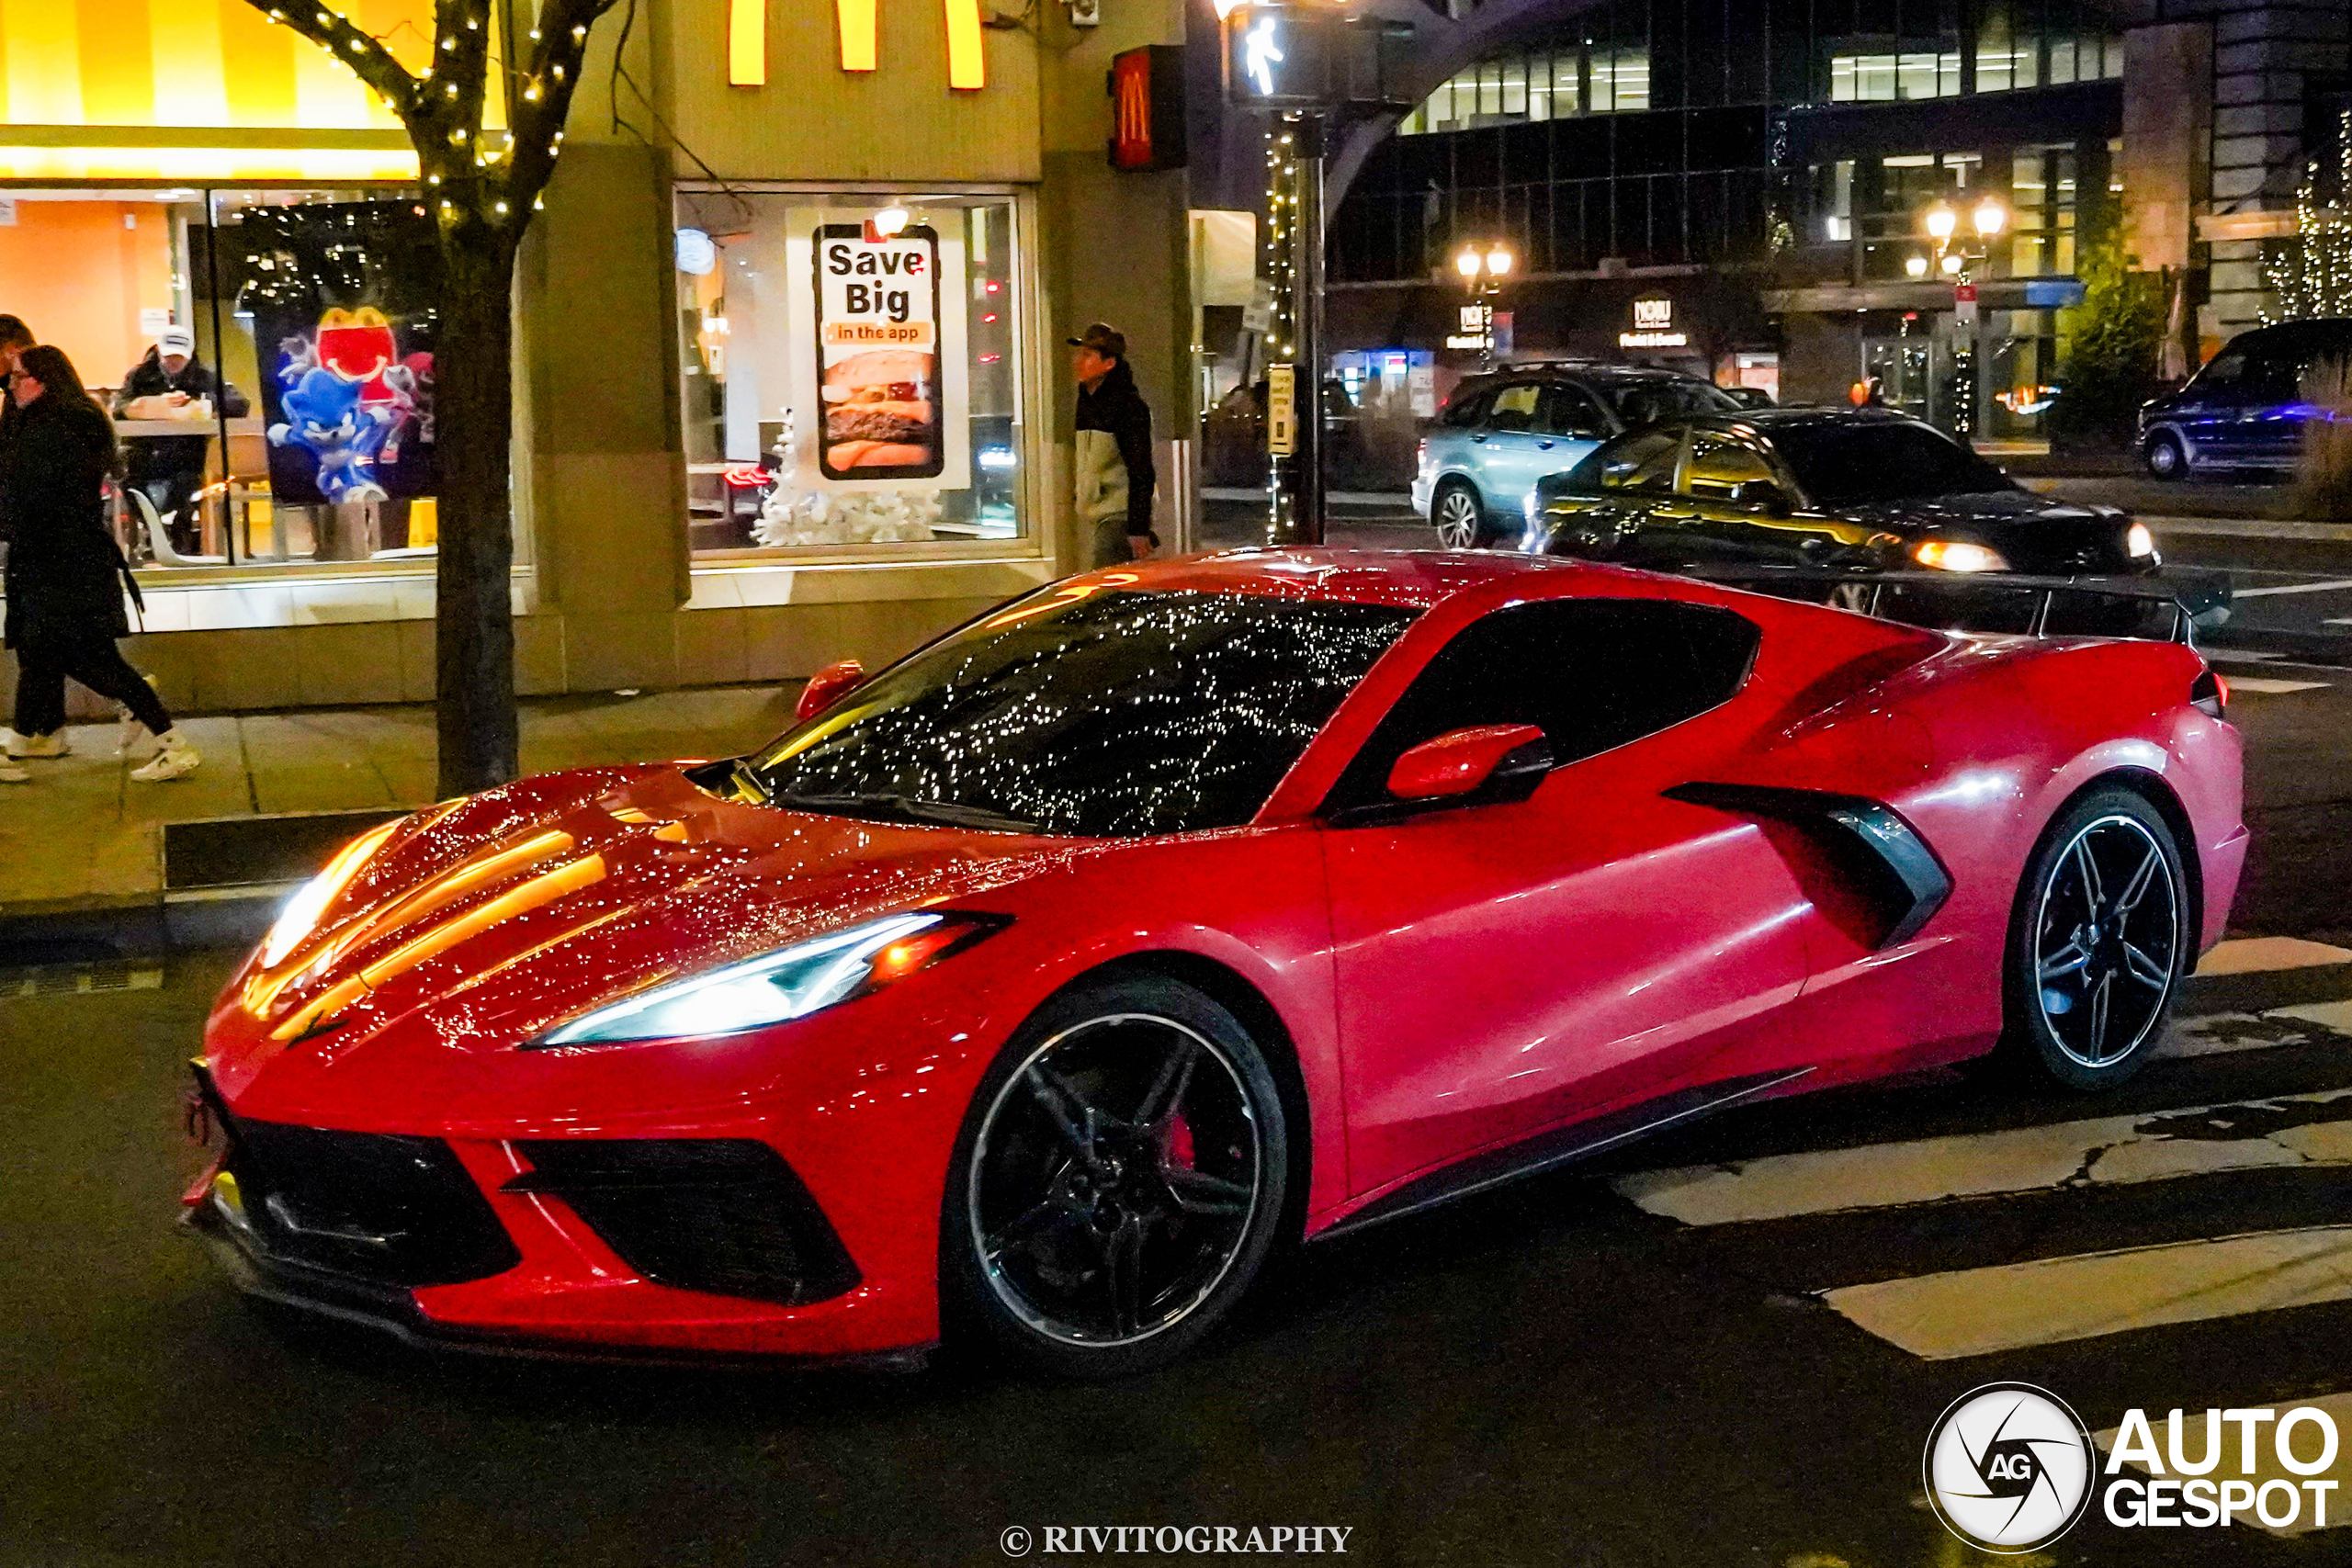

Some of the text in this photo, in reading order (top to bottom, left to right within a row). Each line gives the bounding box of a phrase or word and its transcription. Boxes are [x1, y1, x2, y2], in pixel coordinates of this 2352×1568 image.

[829, 244, 926, 276] Save
[846, 280, 910, 323] Big
[838, 326, 919, 342] in the app
